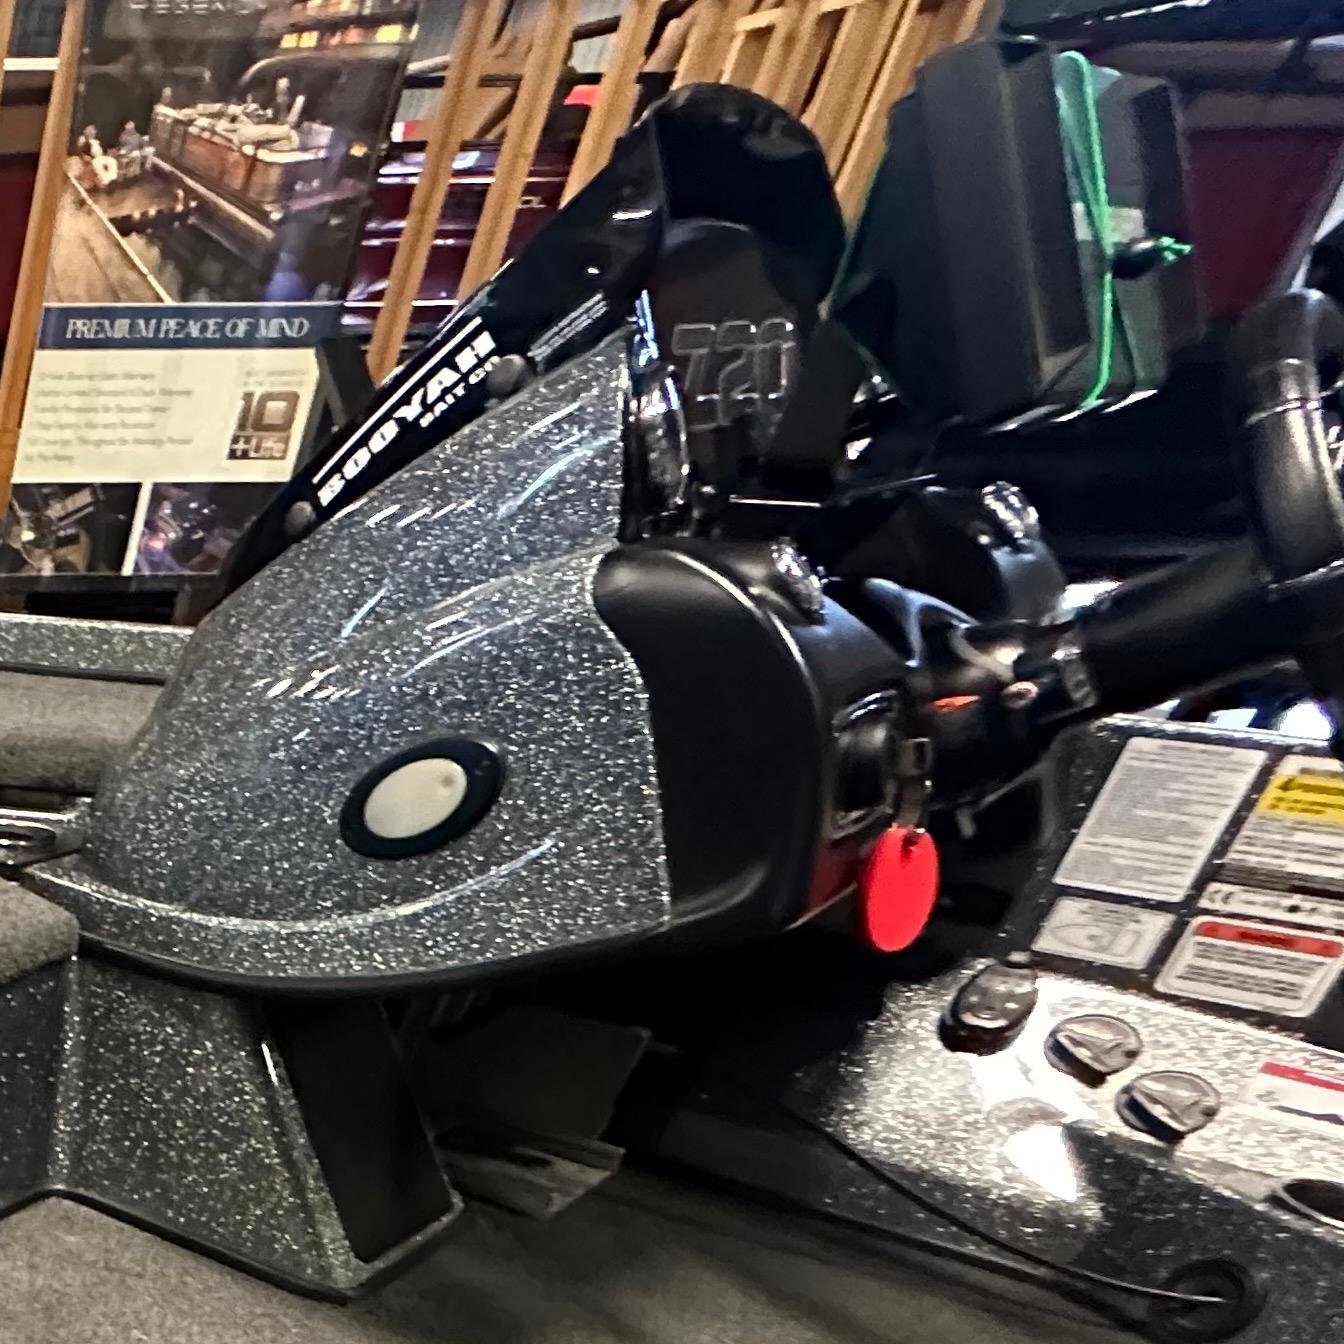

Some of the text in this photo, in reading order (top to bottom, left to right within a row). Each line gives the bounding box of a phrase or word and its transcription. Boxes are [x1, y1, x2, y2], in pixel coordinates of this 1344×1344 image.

[65, 317, 310, 339] PREMIUM PEACE OF MIND
[234, 390, 301, 433] 10
[316, 329, 497, 507] BOOYAH
